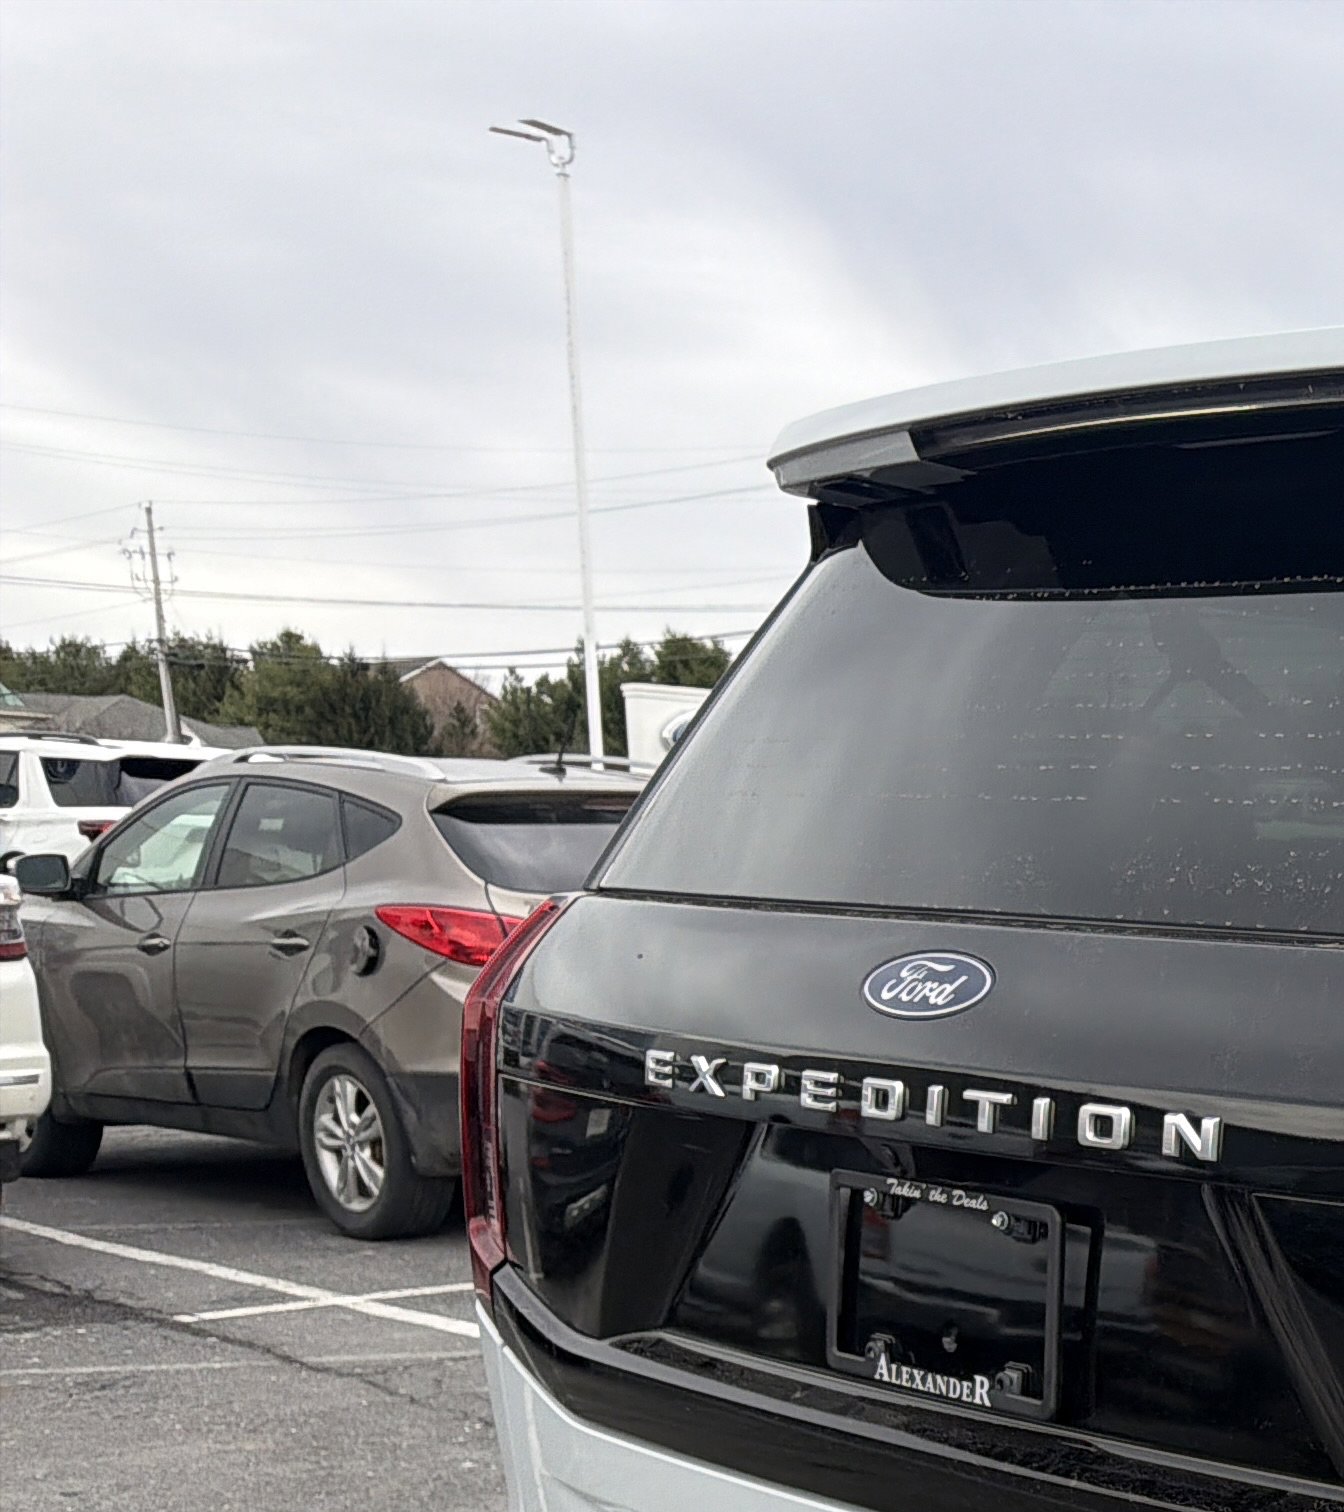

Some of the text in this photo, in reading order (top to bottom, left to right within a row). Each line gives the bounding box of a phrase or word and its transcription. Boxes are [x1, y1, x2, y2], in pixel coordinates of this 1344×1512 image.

[880, 960, 968, 1006] Ford
[644, 1048, 1224, 1163] EXPEDITION
[886, 1177, 990, 1211] Takin' the Deals
[873, 1352, 992, 1408] ALEXANDER
